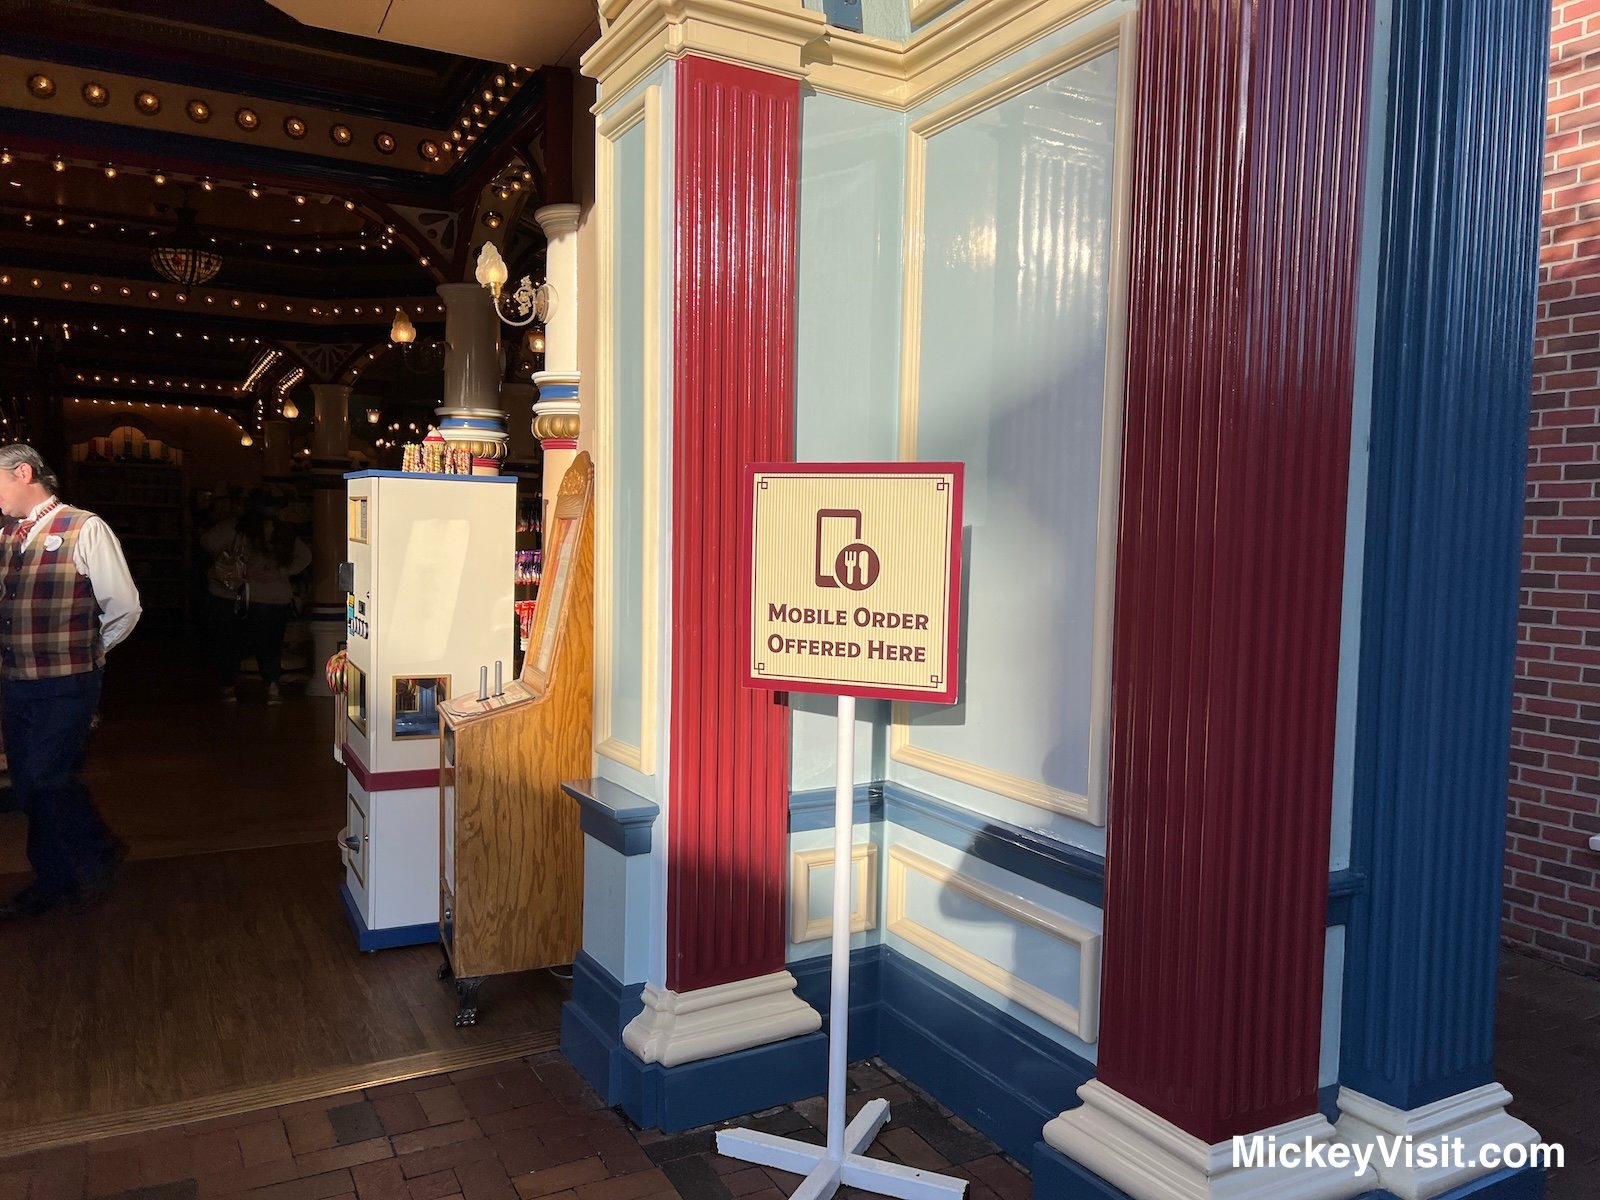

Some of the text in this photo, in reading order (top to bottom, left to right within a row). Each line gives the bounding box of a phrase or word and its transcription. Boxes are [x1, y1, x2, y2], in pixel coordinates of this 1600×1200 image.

[768, 603, 929, 630] MOBILE ORDER
[767, 633, 926, 663] OFFERED HERE
